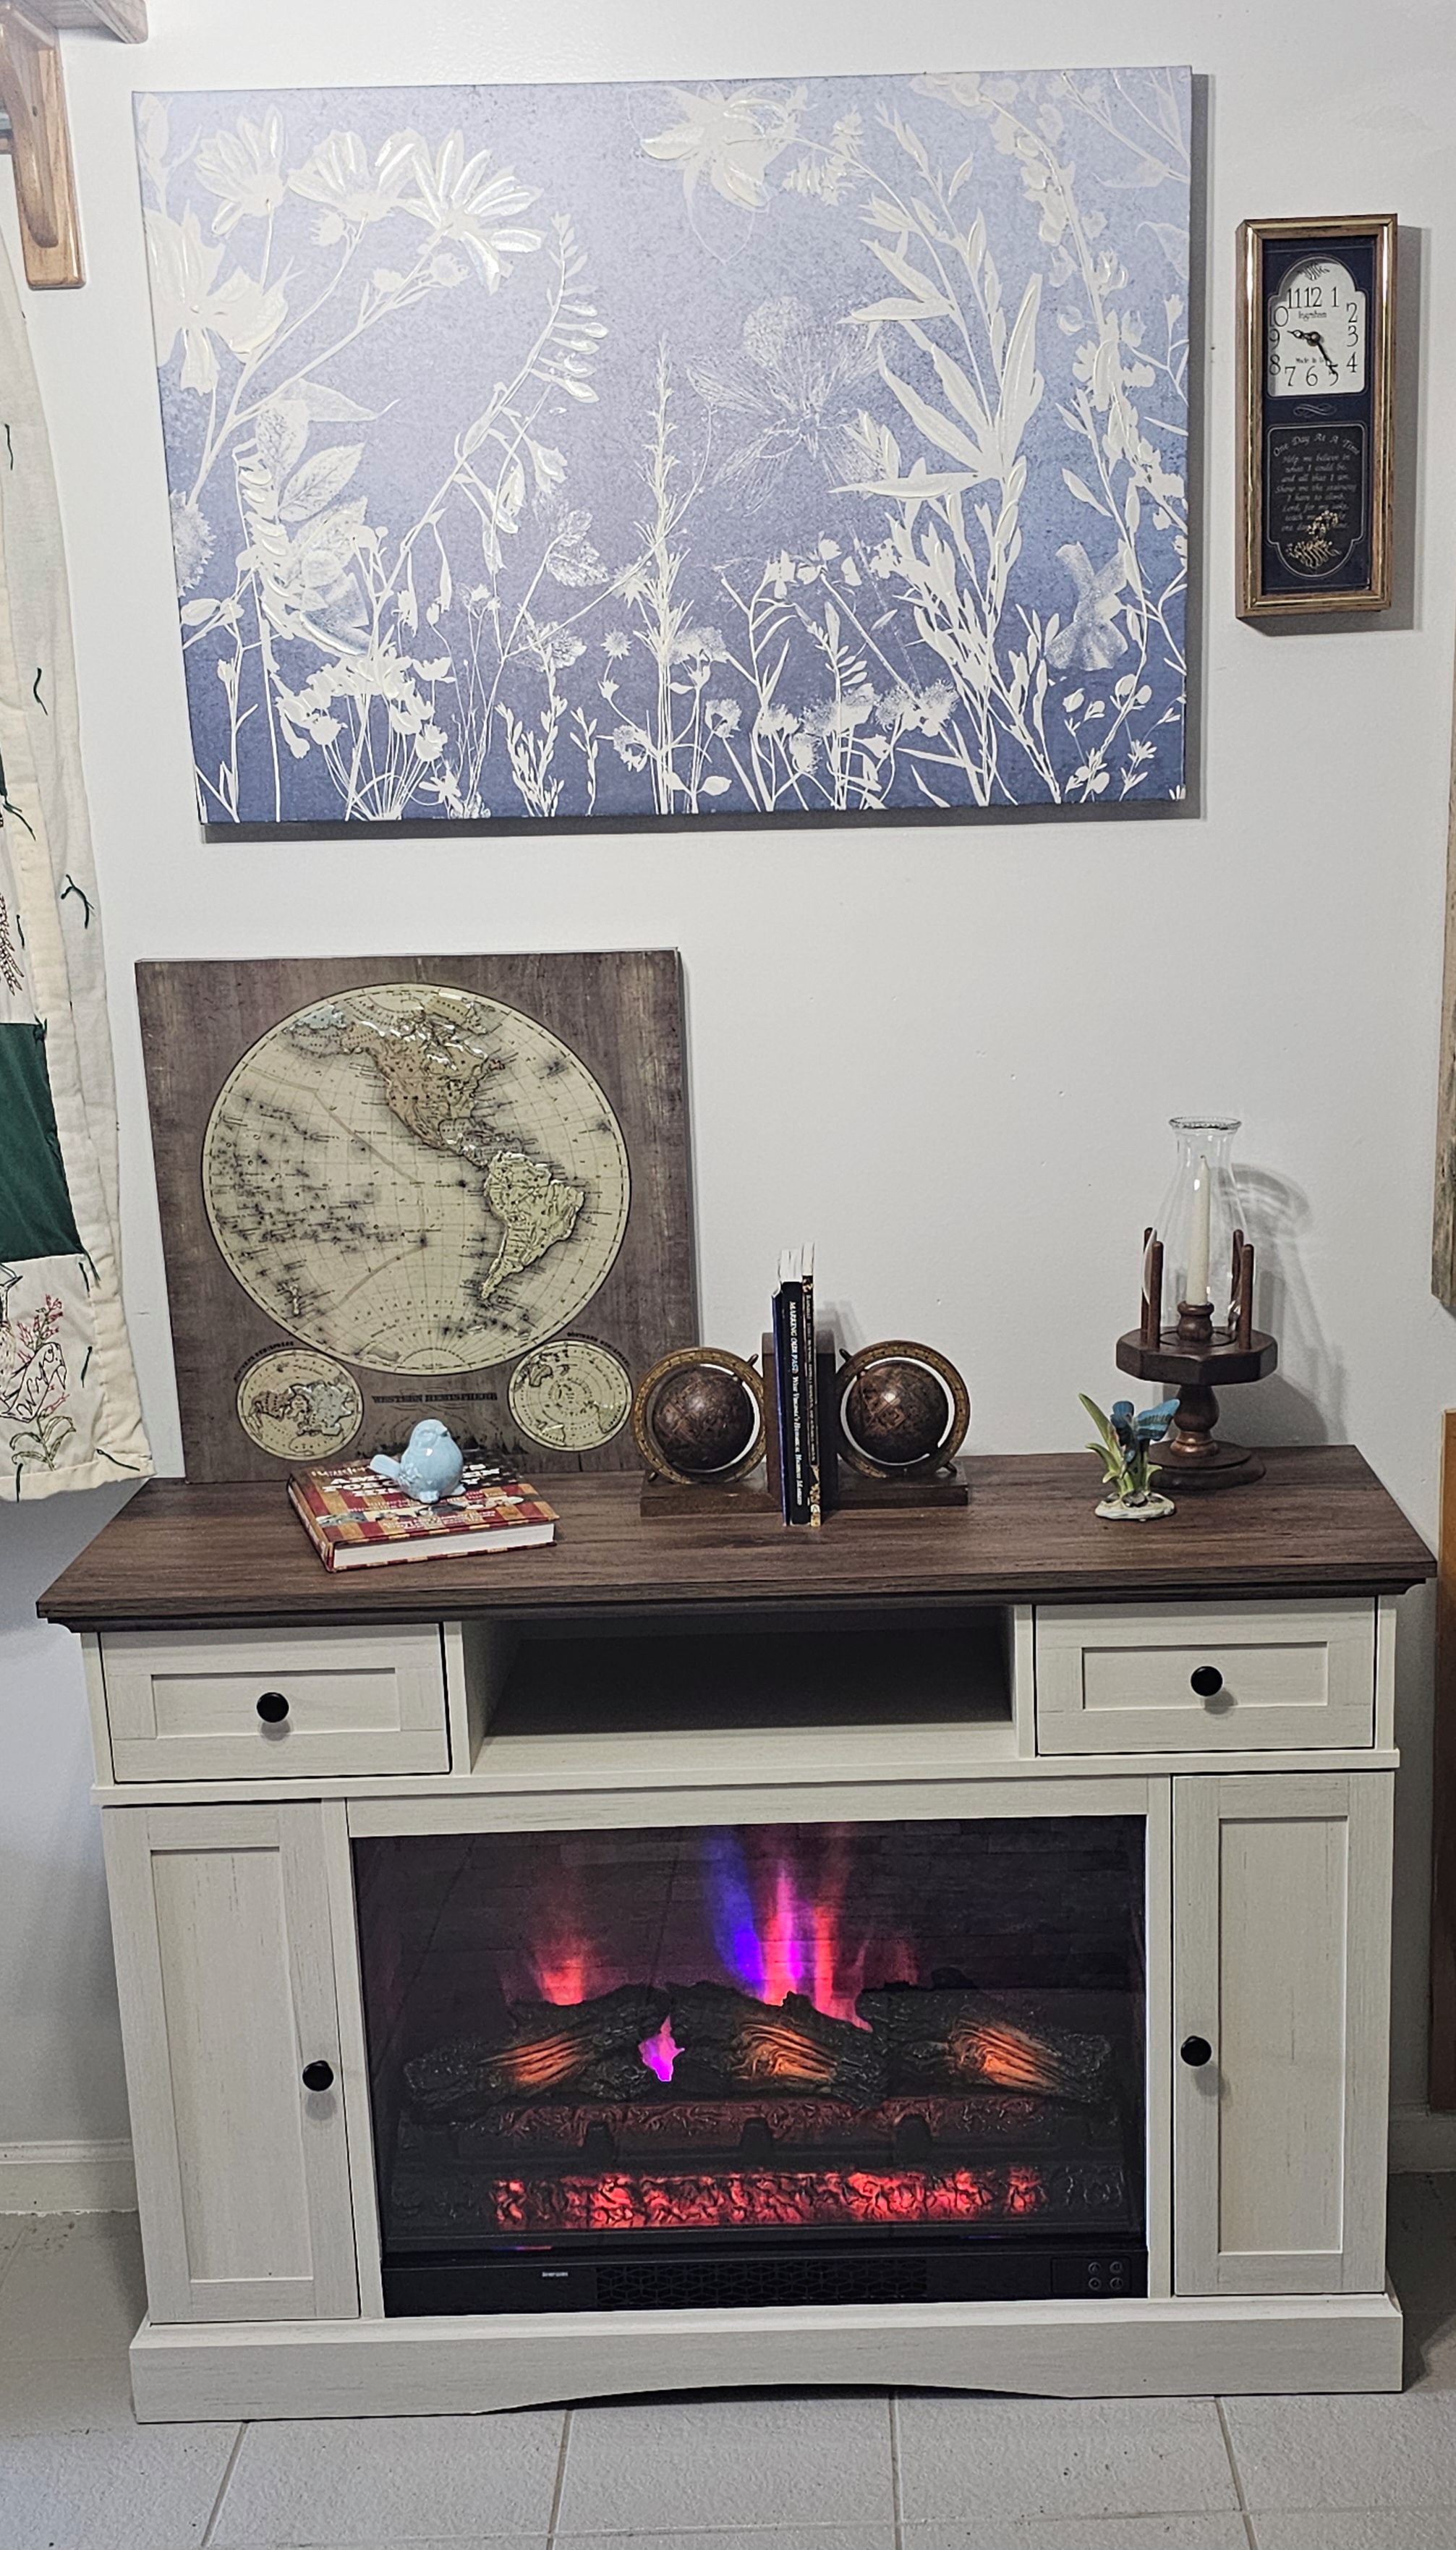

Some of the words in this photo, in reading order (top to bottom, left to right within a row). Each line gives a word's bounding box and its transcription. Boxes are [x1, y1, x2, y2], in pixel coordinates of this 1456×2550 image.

[1287, 288, 1302, 309] 11
[1304, 286, 1322, 307] 12
[1332, 286, 1340, 307] 1
[1346, 302, 1358, 323] 2
[1269, 328, 1280, 350] 9
[1346, 326, 1358, 347] 3
[1269, 354, 1281, 375] 8
[1346, 352, 1358, 373] 4
[1285, 366, 1296, 386] 7
[1306, 365, 1318, 386] 6
[1273, 443, 1288, 457] One
[1292, 435, 1310, 446] Day
[1342, 438, 1360, 455] Time
